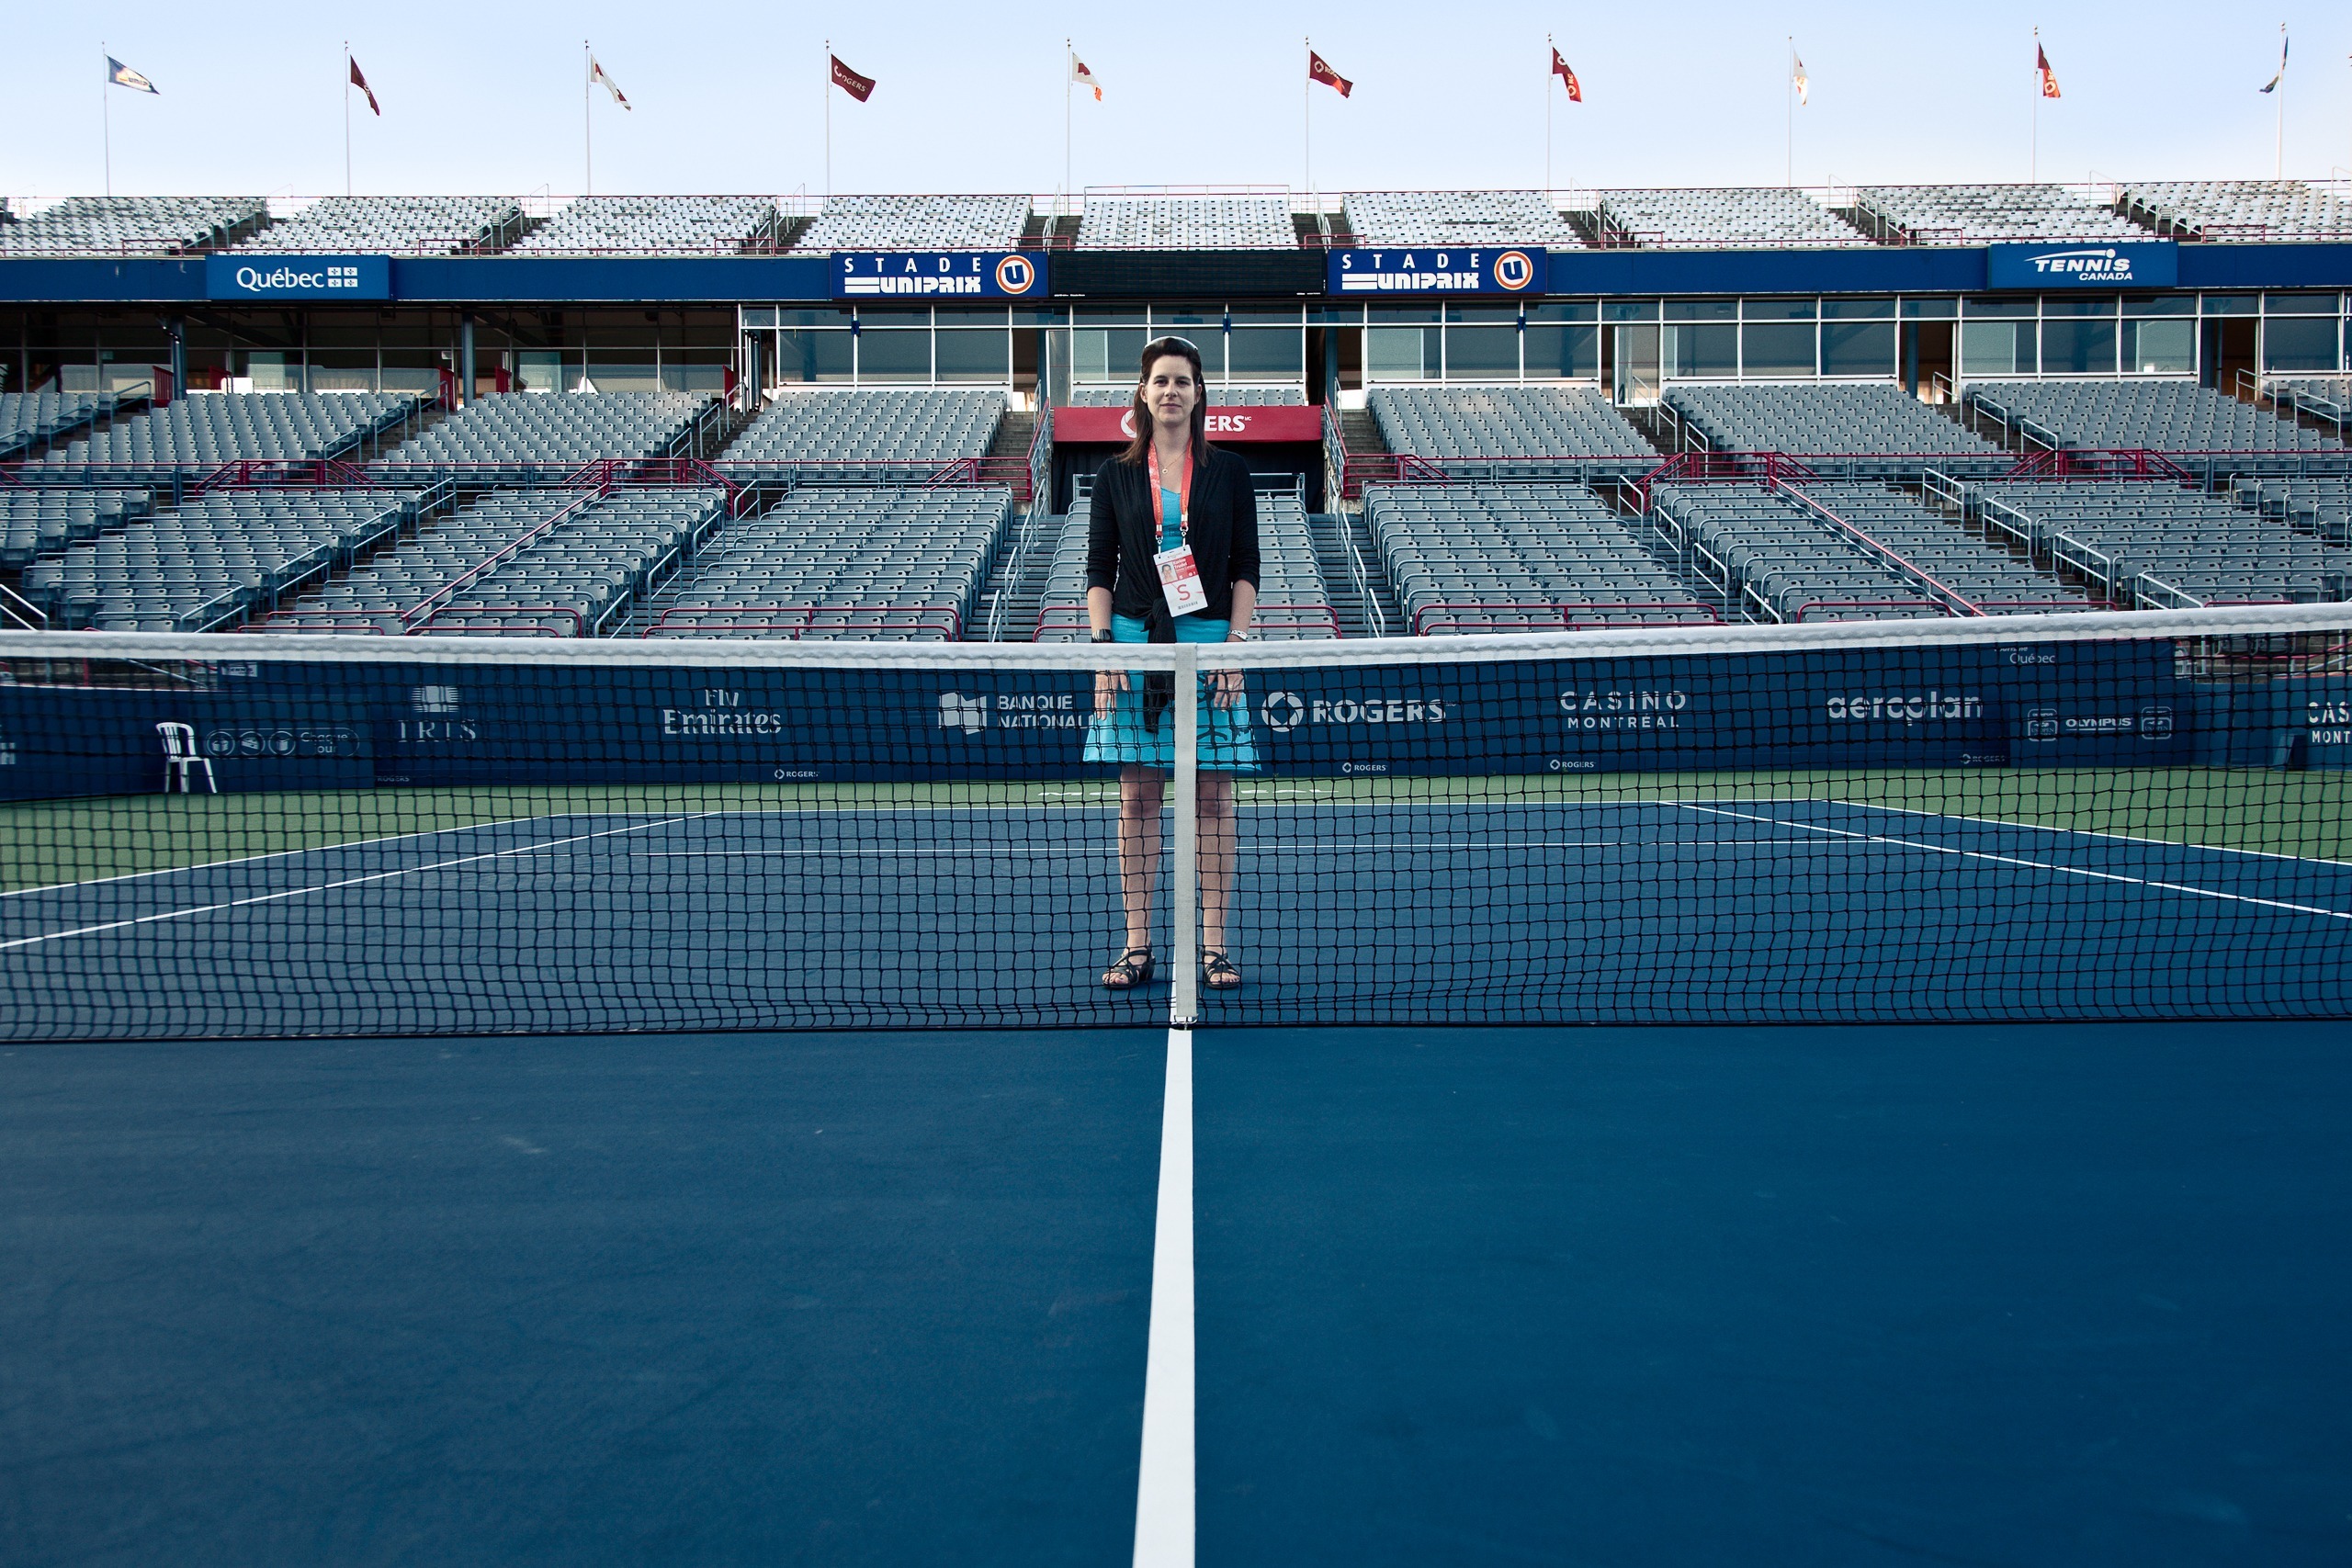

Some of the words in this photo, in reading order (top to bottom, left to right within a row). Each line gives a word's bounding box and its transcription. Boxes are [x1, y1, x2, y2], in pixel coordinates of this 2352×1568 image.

[844, 257, 981, 273] STADE
[1341, 253, 1480, 270] STADE
[2034, 258, 2131, 273] TENNIS
[236, 266, 324, 292] Québec
[877, 276, 981, 294] UNIPRIX
[1376, 272, 1479, 290] UNIPRIX
[2078, 272, 2133, 281] CANADA
[1204, 415, 1246, 432] ERS
[1177, 584, 1191, 601] S
[998, 694, 1073, 710] BANQUE
[1560, 690, 1687, 711] CASINO
[1826, 691, 1984, 727] aeroplan
[1313, 699, 1447, 723] ROGERS
[2308, 701, 2350, 723] CAS
[662, 709, 782, 735] Emirates
[1567, 714, 1679, 728] MONTRÉAL
[2065, 717, 2132, 728] OLYMPUS
[398, 718, 477, 743] IRIS
[2312, 730, 2351, 744] MONT
[1562, 761, 1595, 769] ROGERS
[786, 770, 819, 778] ROGERS
